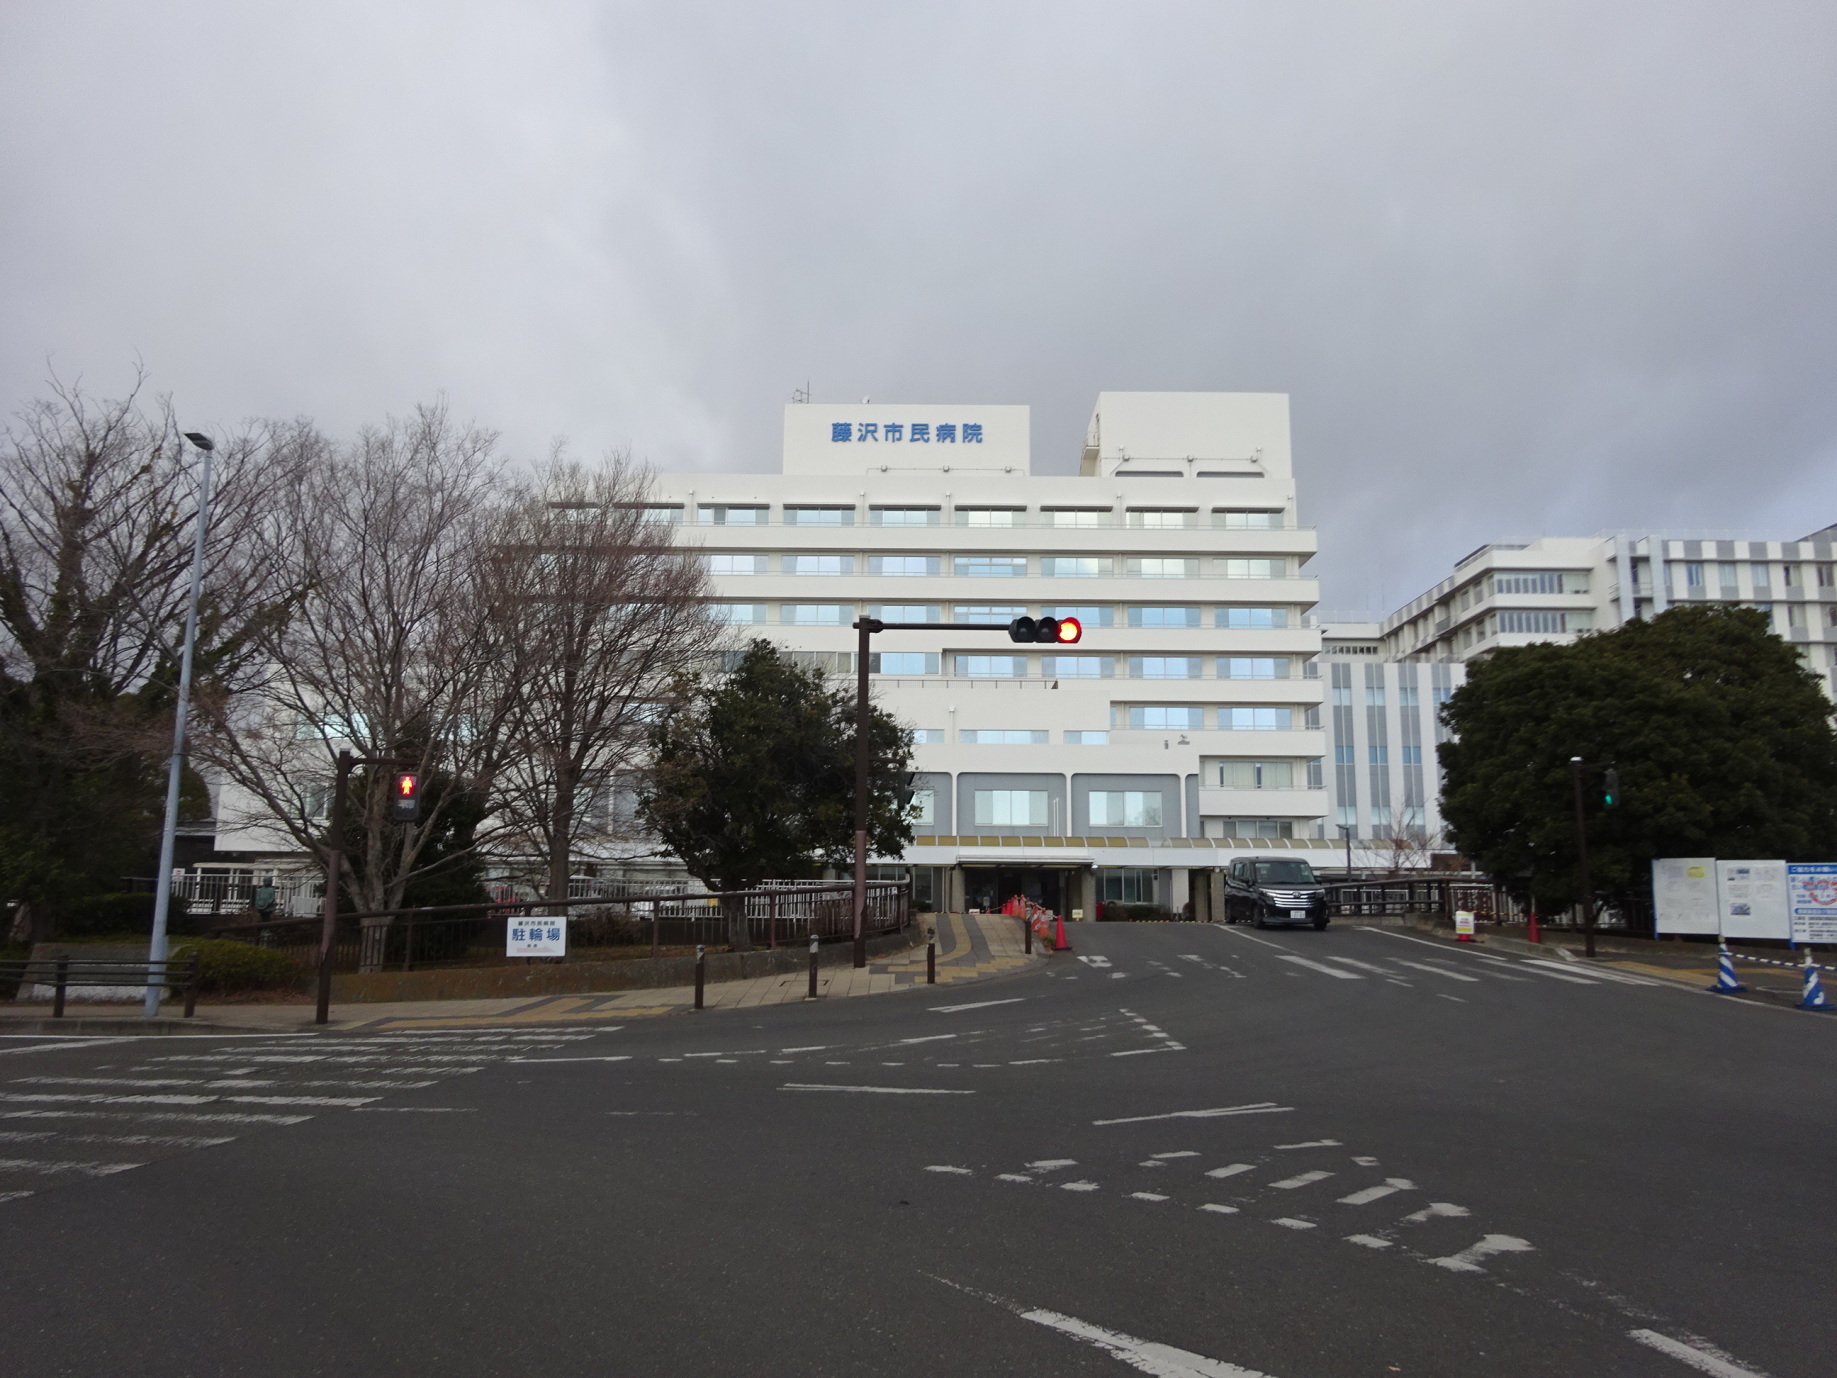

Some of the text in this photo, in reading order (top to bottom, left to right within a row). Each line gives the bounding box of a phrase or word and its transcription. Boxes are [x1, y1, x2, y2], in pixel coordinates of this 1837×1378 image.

[831, 422, 983, 443] 藤沢市民病院
[512, 928, 560, 941] 駐輪場
